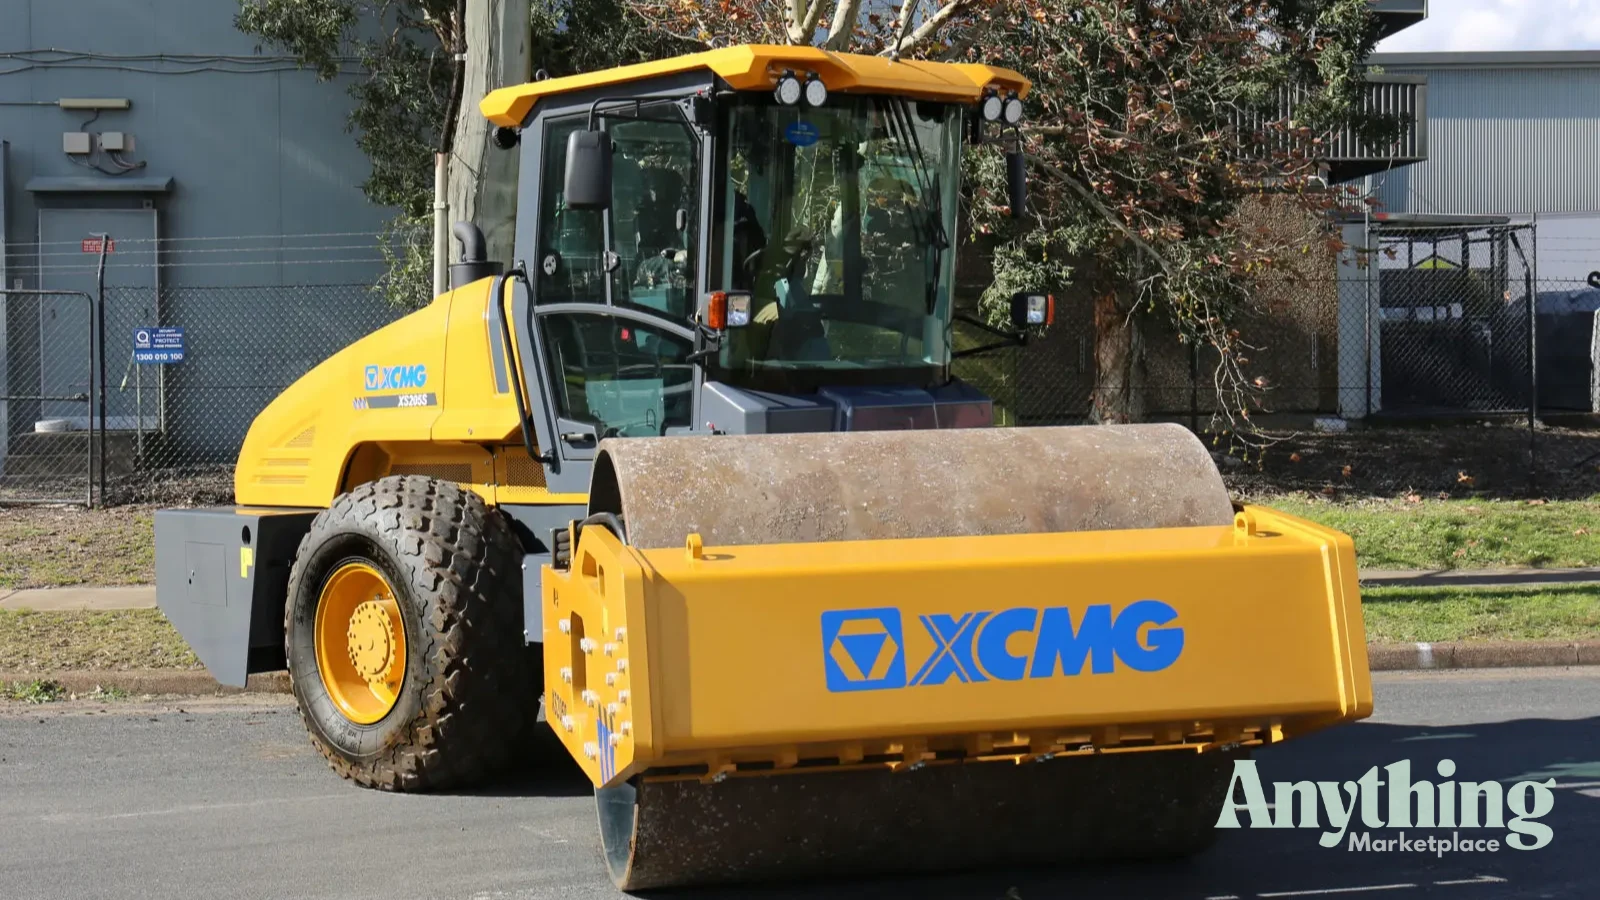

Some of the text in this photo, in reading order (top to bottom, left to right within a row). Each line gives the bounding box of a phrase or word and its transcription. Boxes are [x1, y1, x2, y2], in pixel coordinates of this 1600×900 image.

[136, 353, 183, 361] 1300 010 100
[379, 364, 427, 389] XCMG
[398, 393, 428, 407] XS205S
[906, 599, 1185, 687] XCMG
